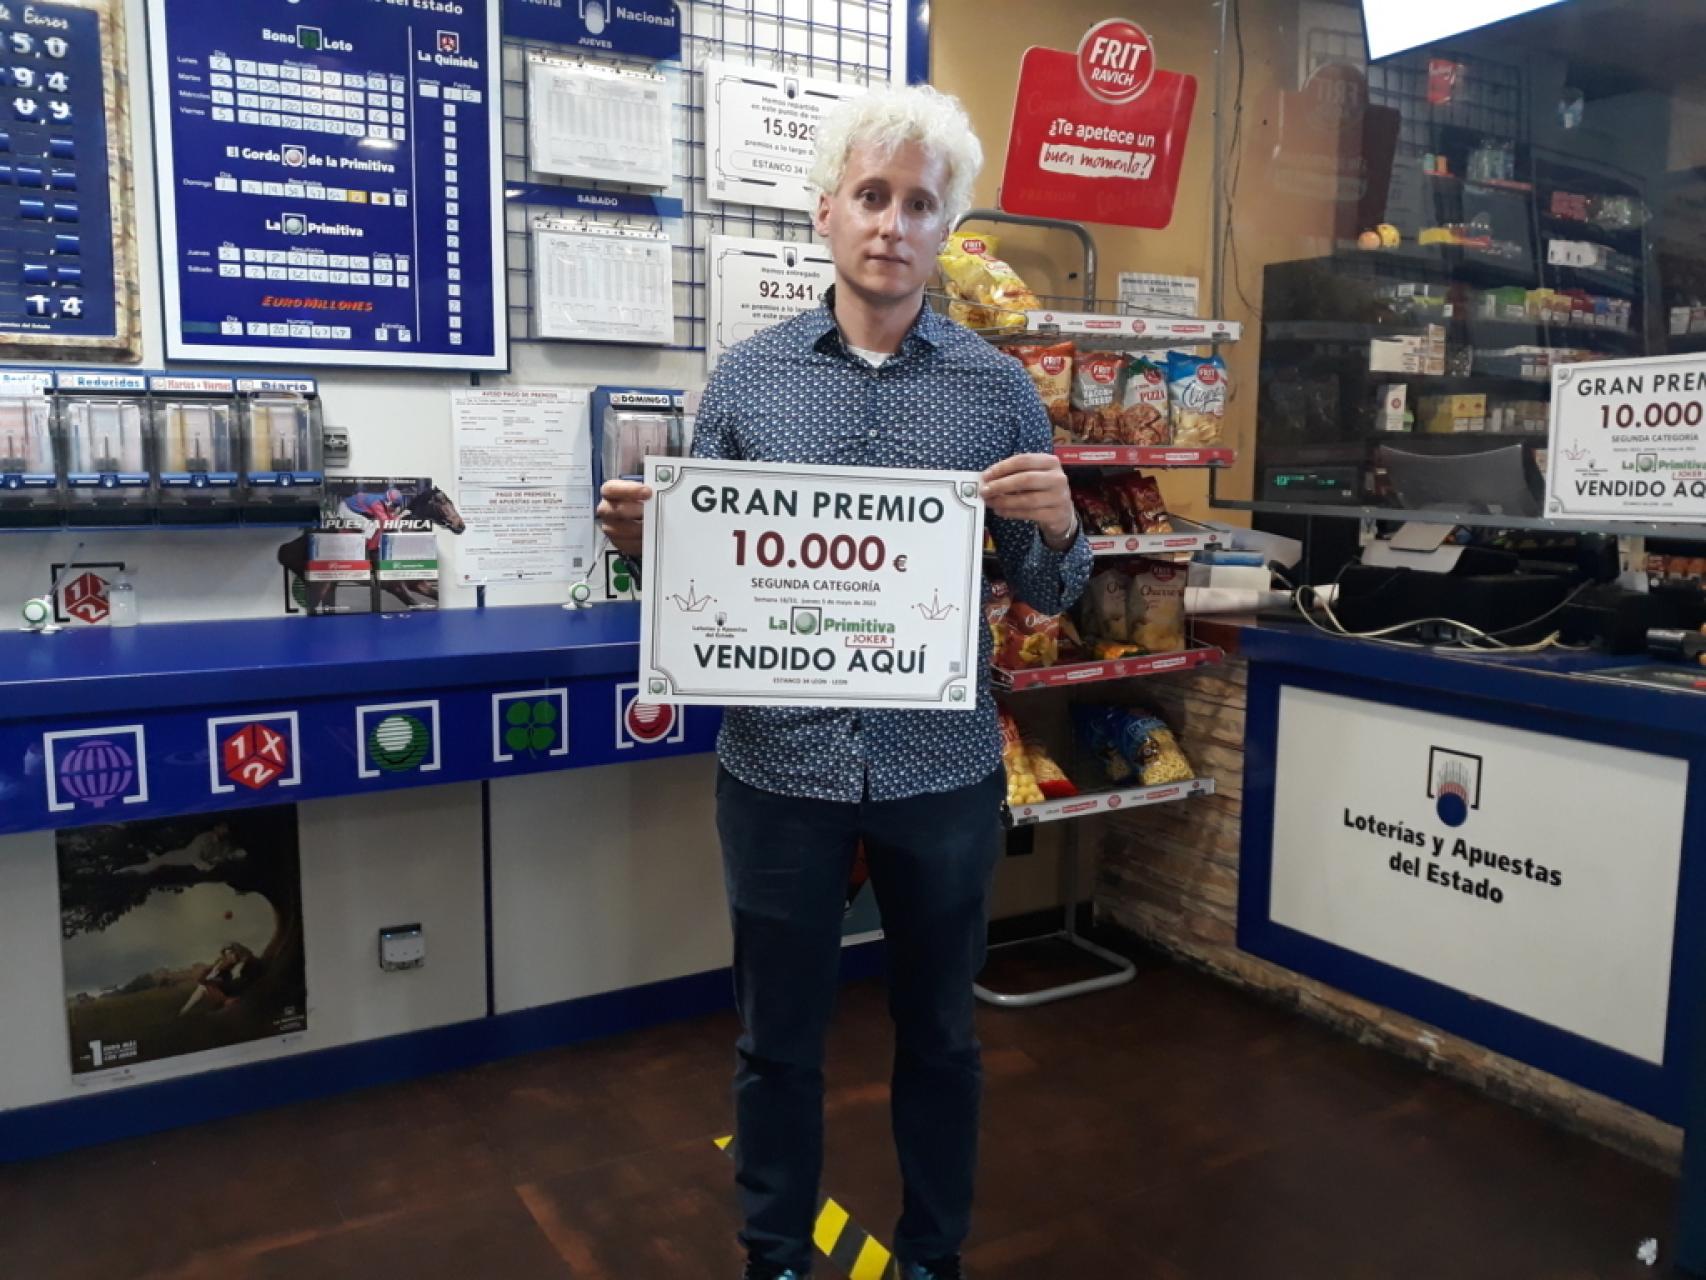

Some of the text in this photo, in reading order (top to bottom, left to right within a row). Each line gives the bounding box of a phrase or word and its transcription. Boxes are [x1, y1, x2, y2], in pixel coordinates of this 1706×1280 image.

[616, 6, 676, 28] Nacional
[262, 28, 353, 52] Bono Loto
[578, 36, 613, 49] JUEVES
[417, 50, 479, 70] La Quiniela
[1088, 36, 1148, 71] FRIT
[1091, 67, 1135, 87] RAVICH
[1048, 117, 1156, 149] ¿Te apetece un
[226, 146, 396, 174] El Gordo de la Primitiva
[752, 159, 793, 173] ESTANCO
[1043, 144, 1075, 167] buen
[265, 219, 365, 238] La Primitiva
[759, 279, 814, 301] 92.341
[77, 376, 141, 388] Reducidas
[261, 381, 308, 391] Diario
[1577, 375, 1644, 397] GRAN
[621, 394, 668, 405] DOMINGO
[1600, 401, 1704, 429] 10.000
[1611, 434, 1650, 444] SEGUNDA
[1575, 479, 1667, 498] VENDIDO
[691, 484, 945, 525] GRAN PREMIO
[732, 529, 909, 574] 10.000 €
[750, 576, 882, 594] SEGUNDA CATEGORÍA
[768, 615, 896, 635] La Primitiva
[852, 633, 888, 646] JOKER
[693, 643, 928, 676] VENDIDO AQUÍ
[1343, 807, 1563, 887] Loterías y Apuestas
[1388, 850, 1504, 904] del Estado
